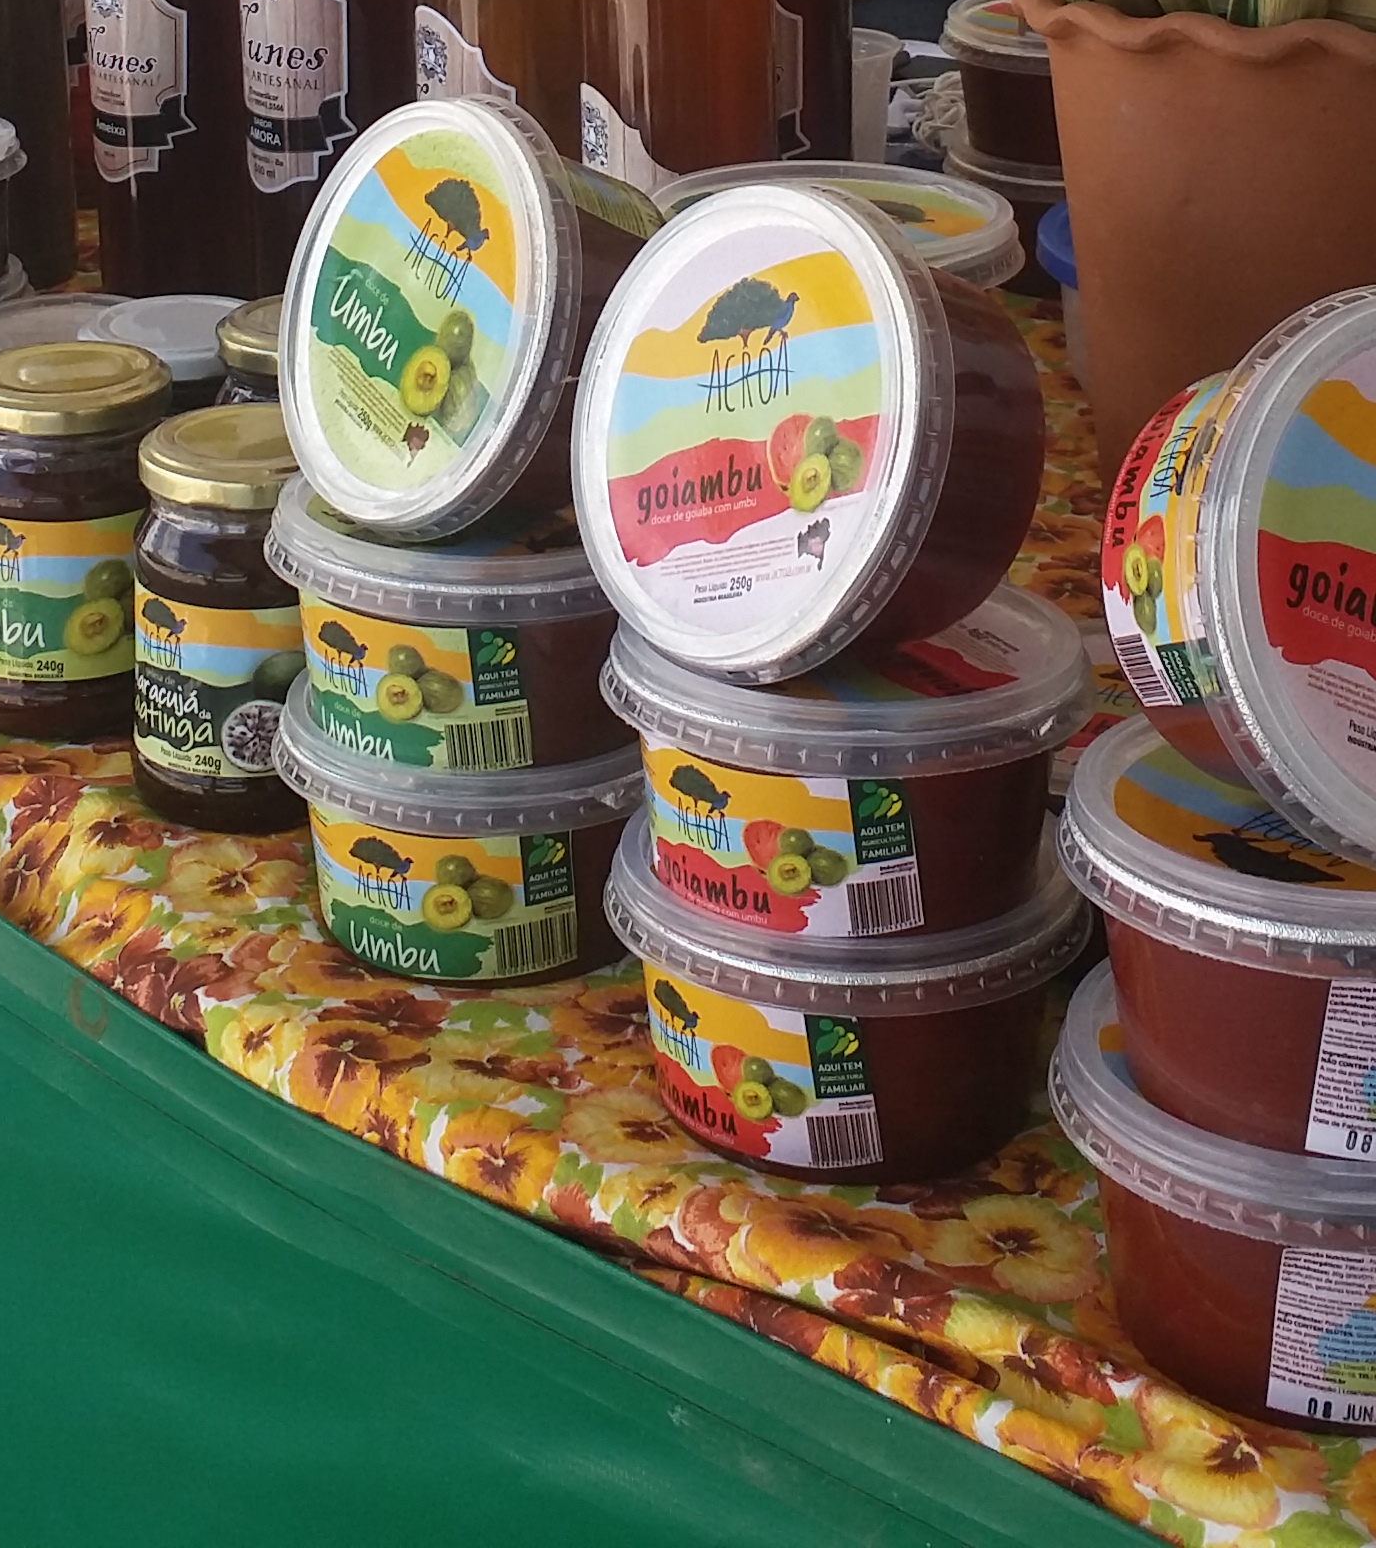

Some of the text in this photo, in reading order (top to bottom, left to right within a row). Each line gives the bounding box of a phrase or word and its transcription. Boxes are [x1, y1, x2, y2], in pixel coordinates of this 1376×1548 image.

[99, 71, 155, 87] ARTESANAL
[251, 69, 321, 91] ARTESANAL
[250, 126, 282, 146] AMORA
[404, 218, 472, 308] ACROA
[330, 274, 400, 371] Umbu
[698, 339, 794, 413] ACROA
[637, 454, 763, 525] goiambu
[651, 496, 757, 525] doce de goiaba com umbu
[730, 575, 752, 593] 250g
[1302, 604, 1330, 626] doce
[1331, 612, 1346, 629] de
[142, 624, 184, 669] ACROA
[37, 659, 65, 673] 240g
[322, 649, 370, 698] ACROA
[477, 668, 519, 682] AQUI TEM
[478, 687, 521, 702] FAMILIAR
[135, 694, 214, 751] aatinga
[199, 709, 211, 720] da
[320, 706, 395, 762] Umbu
[1349, 719, 1366, 735] Peso
[195, 754, 222, 770] 240g
[674, 796, 732, 852] ACROA
[860, 822, 906, 838] AQUI TEM
[861, 844, 908, 859] FAMILIAR
[528, 866, 568, 883] AQUI TEM
[663, 854, 772, 914] goiambu
[354, 863, 413, 912] ACROA
[529, 884, 569, 902] FAMILIAR
[368, 914, 390, 928] doce
[721, 908, 768, 925] com umbu
[348, 919, 441, 974] Umbu
[659, 1009, 702, 1071] ACROA
[818, 1060, 863, 1074] AQUI TEM
[819, 1081, 866, 1095] FAMILIAR
[657, 1066, 738, 1136] oiambu
[1345, 1130, 1373, 1153] 08
